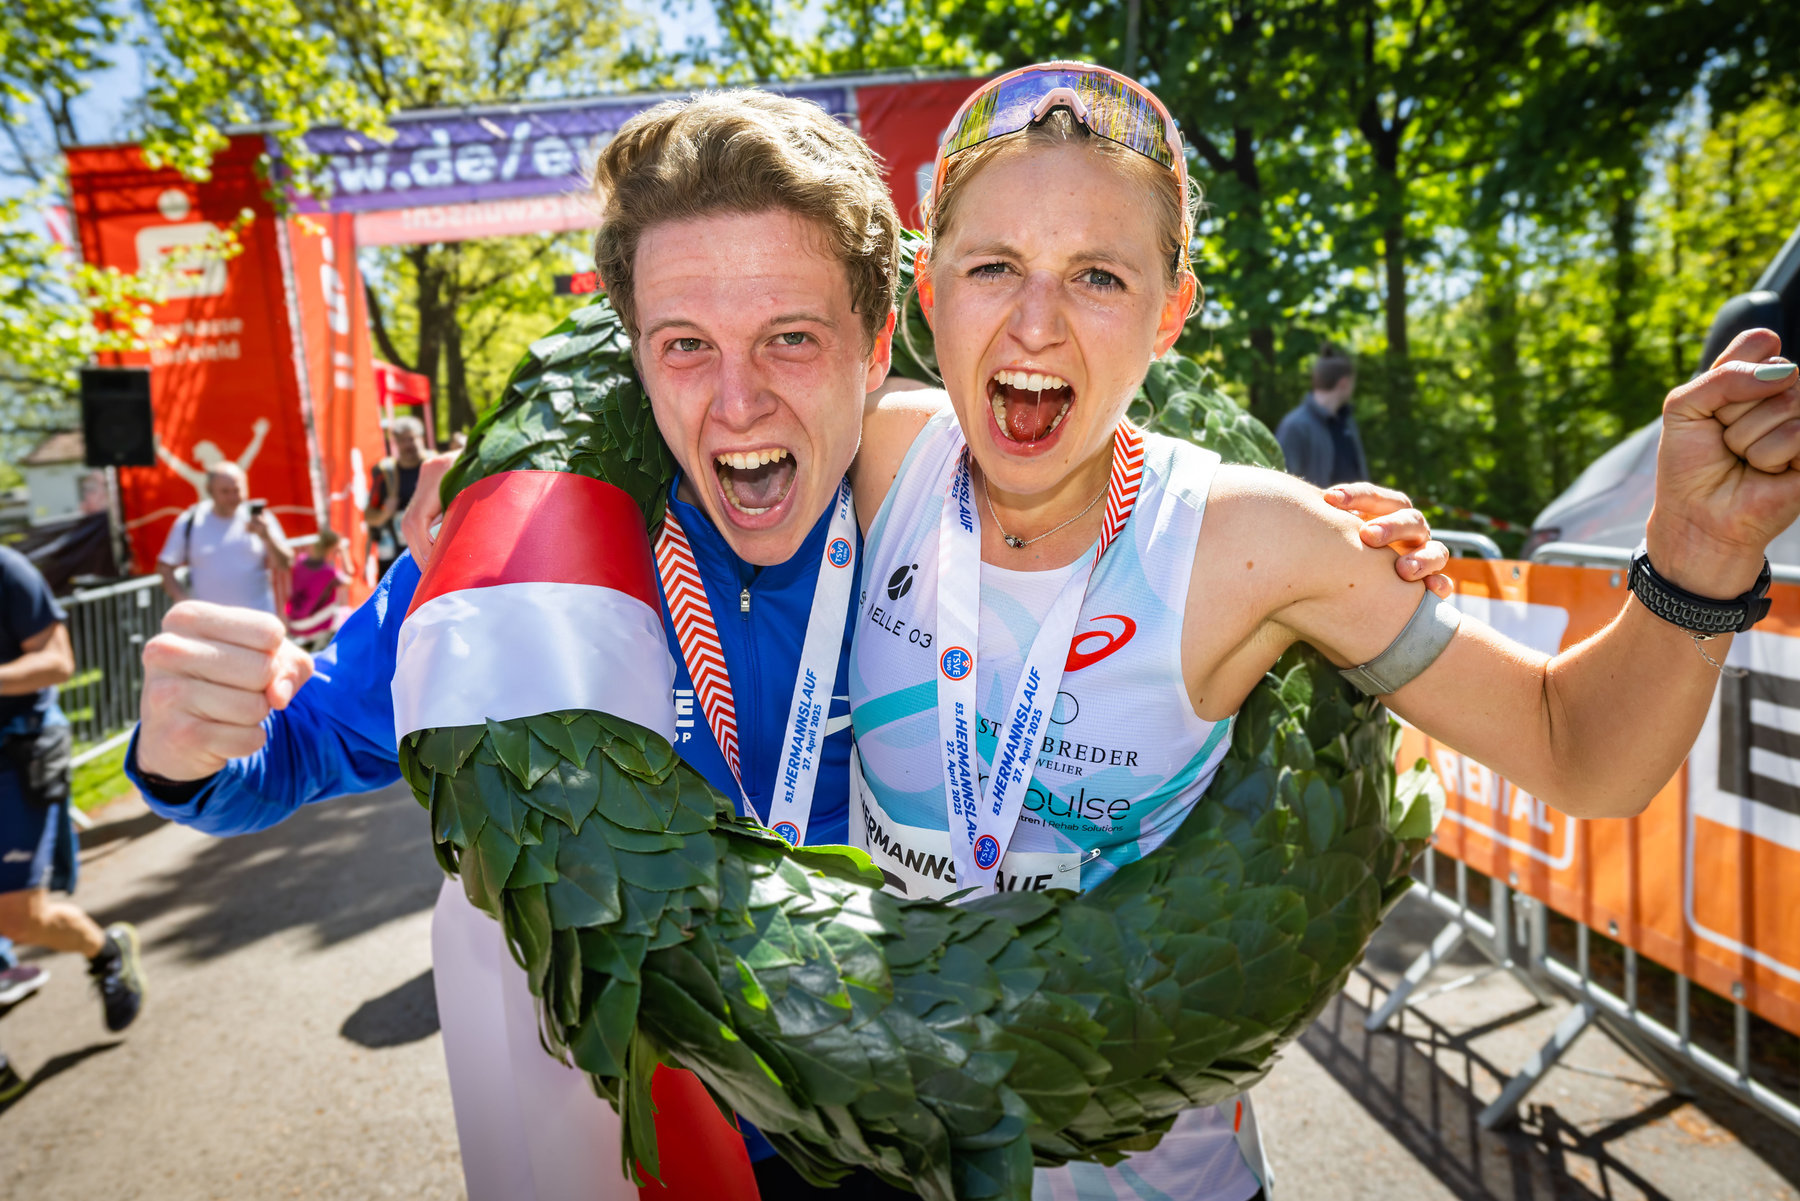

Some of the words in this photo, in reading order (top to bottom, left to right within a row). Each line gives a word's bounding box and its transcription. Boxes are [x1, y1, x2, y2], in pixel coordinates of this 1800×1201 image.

[835, 542, 844, 562] TSVE
[908, 628, 933, 649] 03
[952, 652, 961, 676] TSVE
[811, 704, 822, 728] 2025
[806, 730, 818, 754] April
[1018, 737, 1034, 766] April
[1027, 708, 1043, 736] 2025
[947, 759, 958, 787] April
[951, 789, 963, 816] 2025
[1435, 749, 1554, 835] RENTAL
[1048, 820, 1079, 832] Rehab
[1082, 824, 1124, 832] Solutions
[980, 839, 993, 863] TSVE
